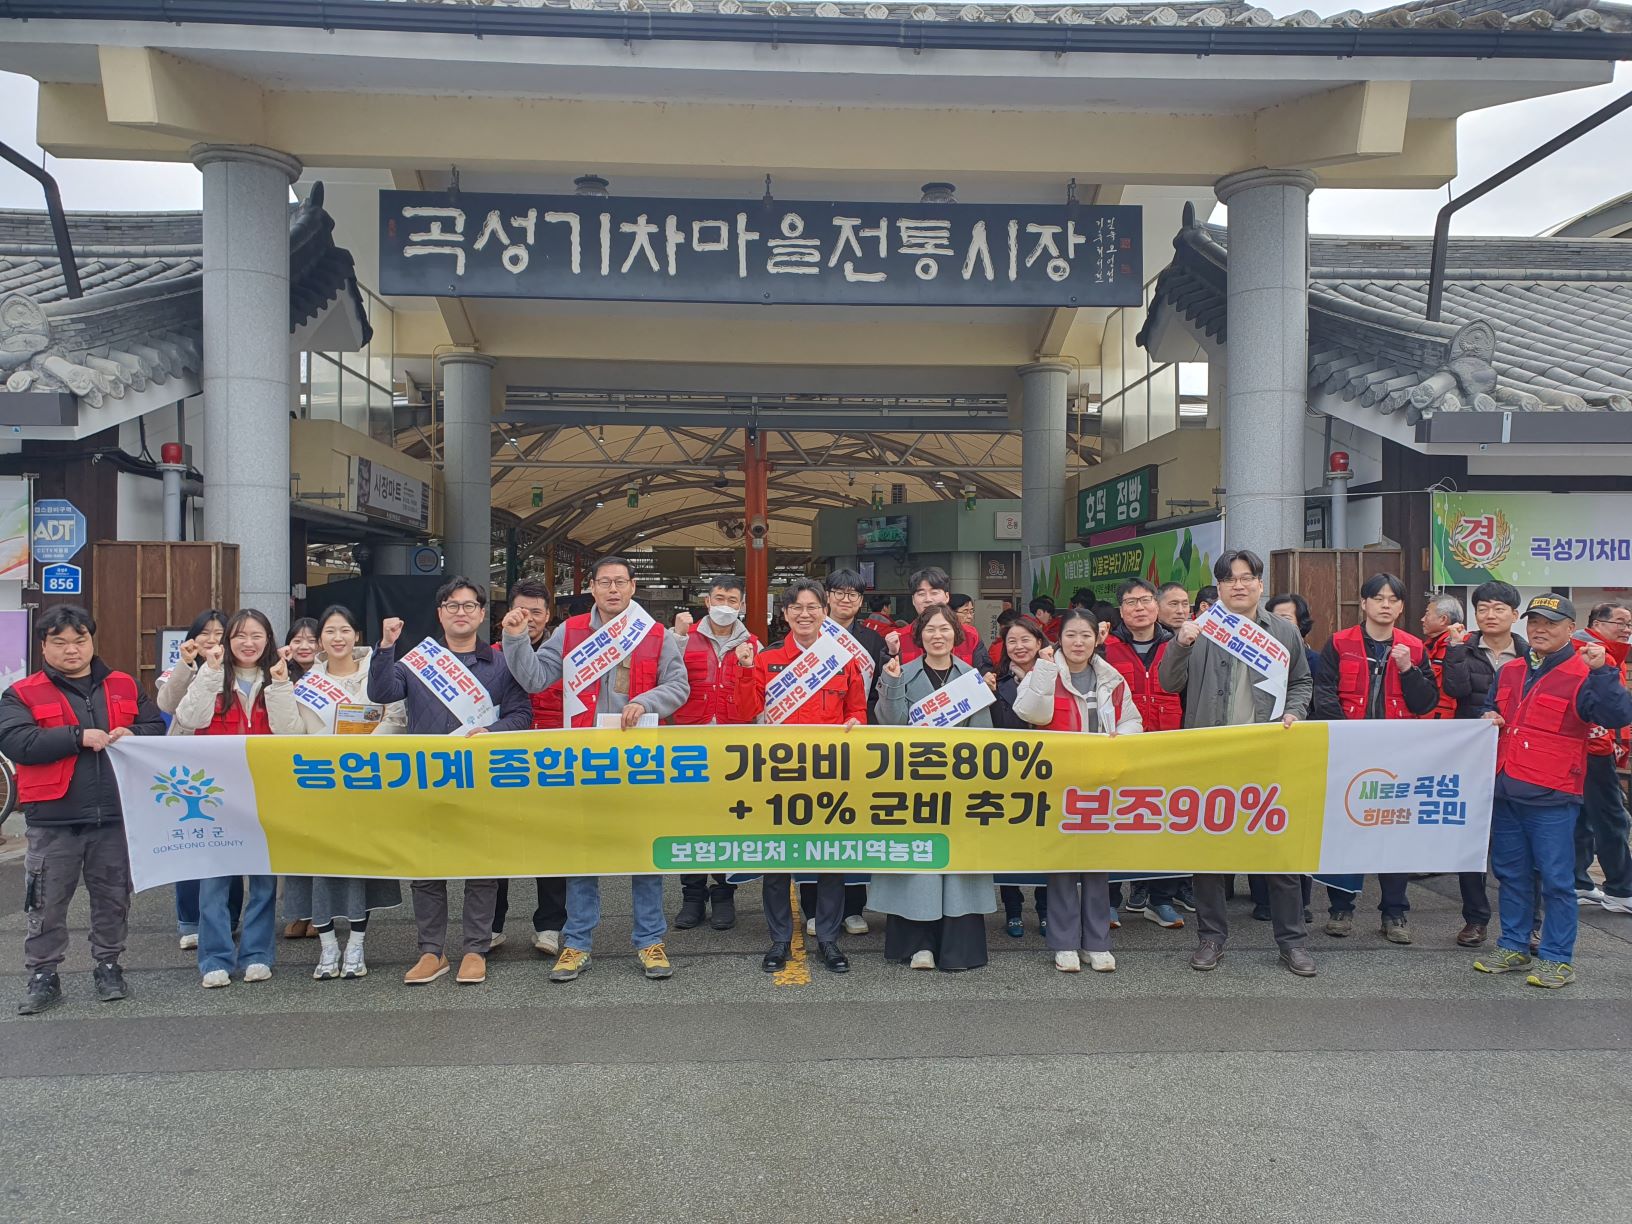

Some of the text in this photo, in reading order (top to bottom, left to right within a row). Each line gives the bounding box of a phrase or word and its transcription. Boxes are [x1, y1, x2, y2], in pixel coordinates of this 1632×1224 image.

[374, 474, 401, 502] 시장마트
[1086, 475, 1141, 529] 호떡 점빵
[33, 520, 74, 540] ADT
[1460, 515, 1495, 557] 경
[1064, 560, 1084, 580] 아름다운
[1092, 549, 1143, 577] 산불로부터 지켜요
[49, 578, 74, 590] 856
[568, 618, 647, 692] 농기계 안전사고
[570, 614, 629, 668] 예방합시다
[1202, 618, 1272, 672] 예방합시다
[1239, 623, 1290, 668] 안전사고
[404, 650, 460, 703] 예방합시다
[417, 640, 486, 705] 기계 안전사고
[804, 654, 840, 691] 농기계
[293, 684, 330, 710] 합시다
[909, 691, 952, 726] 예방합
[932, 698, 972, 727] 농기계
[292, 740, 1053, 790] 농업기계 종합보험료 가입비 기존80%
[1358, 774, 1460, 799] 새로운 곡성
[765, 791, 857, 826] 10%
[870, 791, 952, 826] 군비
[965, 791, 1052, 827] 추가
[1060, 784, 1288, 834] 보조90%
[1364, 801, 1467, 826] 희망찬 군민
[153, 841, 206, 854] GOKSEONG
[172, 827, 225, 840] 곡성군
[670, 840, 787, 863] 보험가입처
[805, 840, 934, 863] NH지역농협
